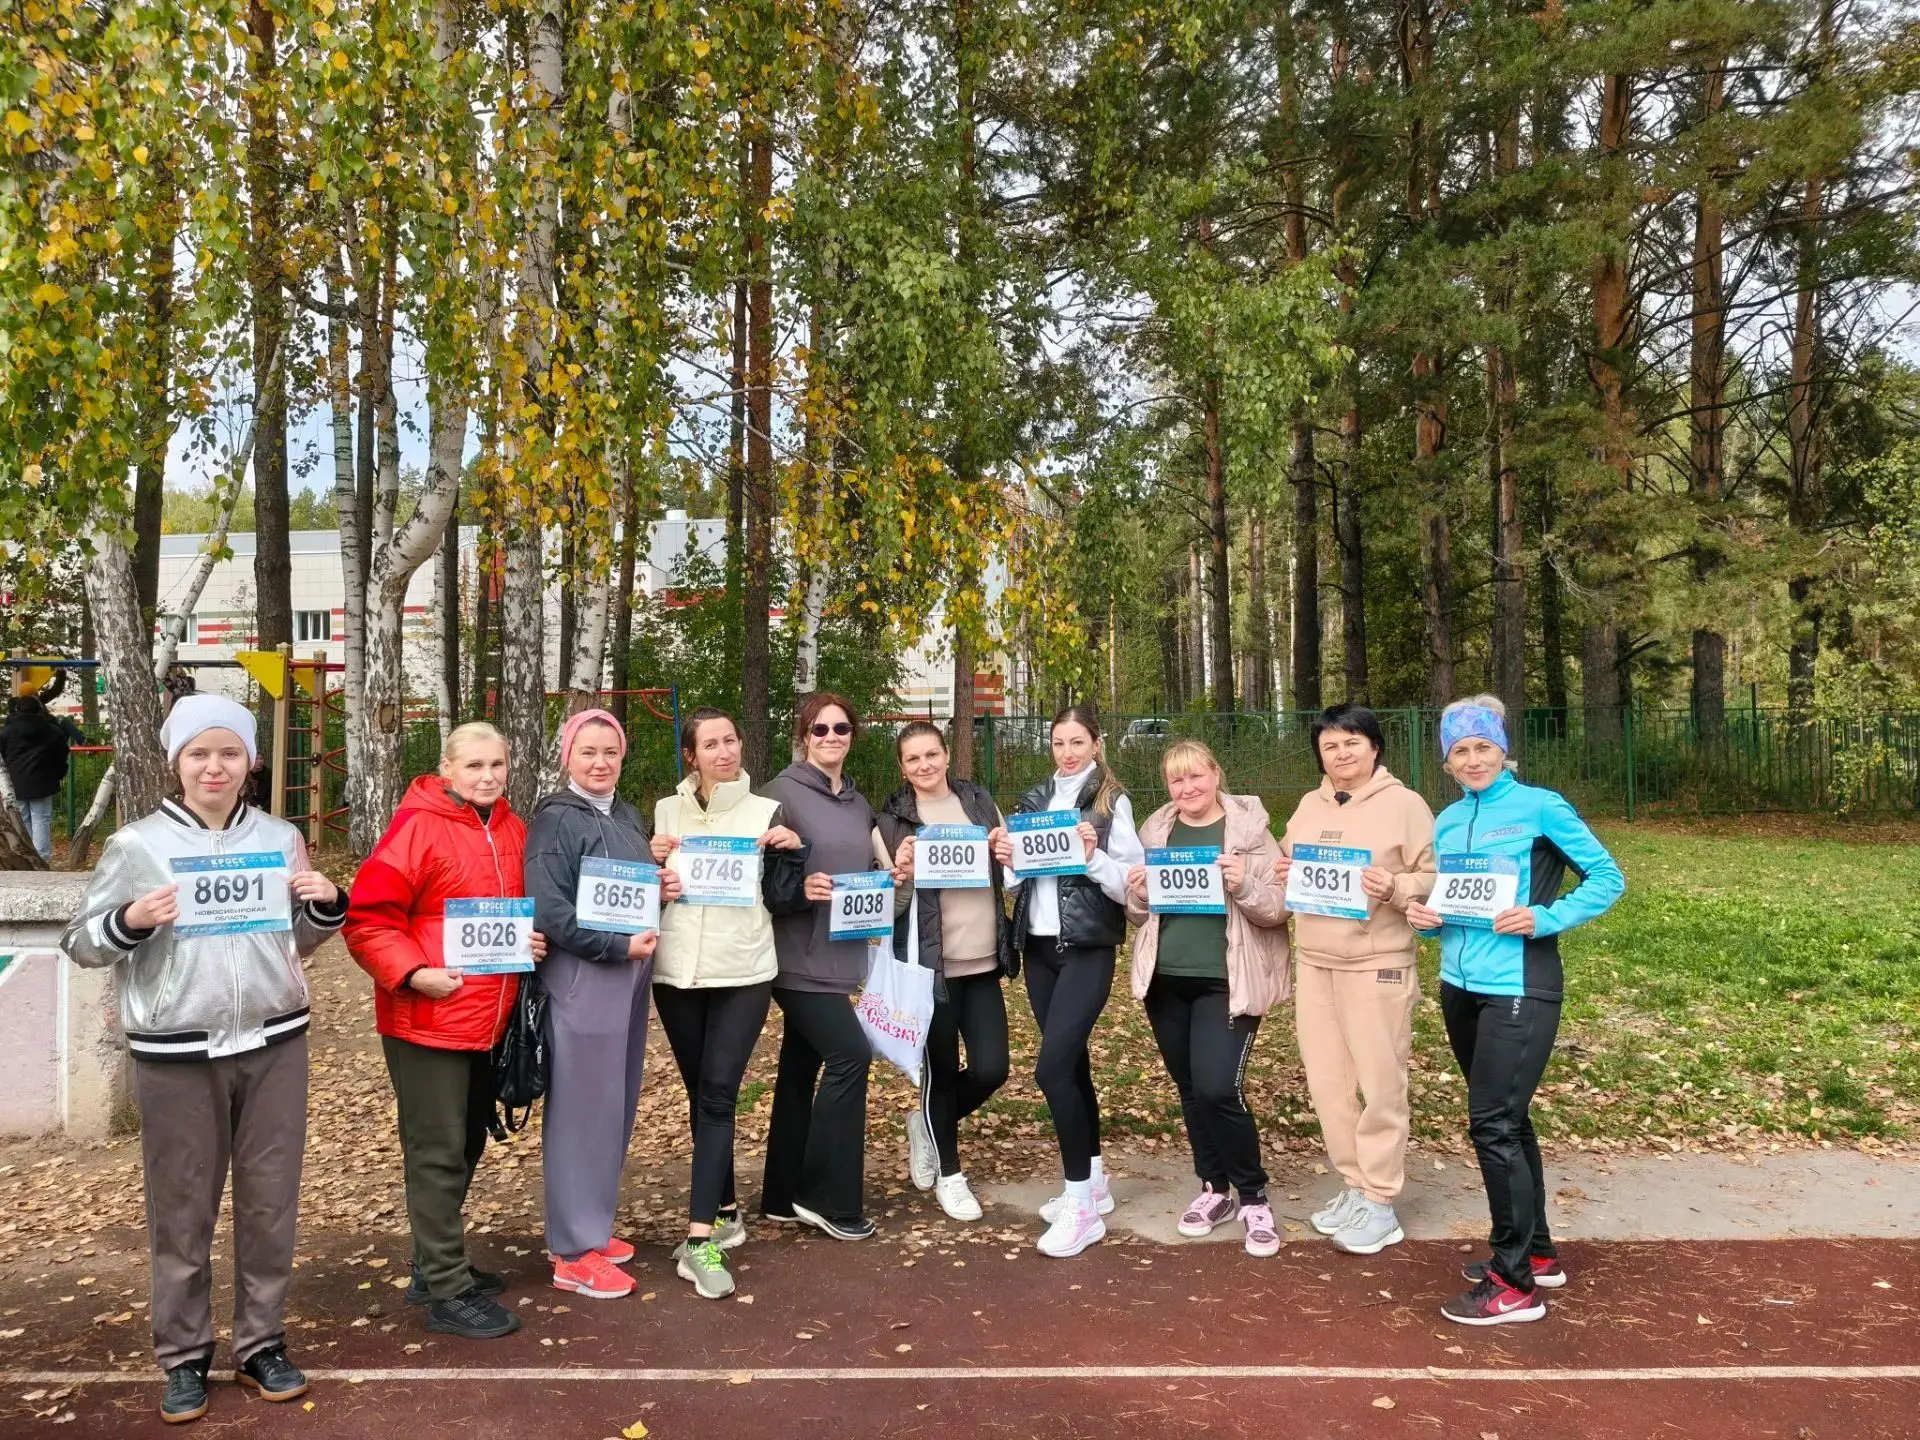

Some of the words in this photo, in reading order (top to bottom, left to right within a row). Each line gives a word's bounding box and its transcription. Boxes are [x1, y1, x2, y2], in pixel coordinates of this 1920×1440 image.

[1031, 815, 1054, 824] КРОСС
[708, 840, 732, 848] КРОСС
[1022, 832, 1070, 856] 8800
[1170, 851, 1194, 859] КРОСС
[1318, 848, 1343, 858] КРОСС
[211, 857, 246, 865] КРОСС
[928, 845, 975, 866] 8860
[1465, 858, 1489, 866] КРОСС
[612, 865, 636, 874] КРОСС
[691, 858, 744, 882] 8746
[1159, 867, 1209, 890] 8098
[1301, 865, 1351, 893] 8631
[194, 873, 264, 904] 8691
[593, 882, 646, 910] 8655
[1445, 878, 1497, 902] 8589
[195, 907, 267, 916] НОВОСИБИРСКАЯ
[479, 901, 504, 910] КРОСС
[843, 892, 884, 916] 8038
[461, 922, 517, 948] 8626
[867, 1007, 921, 1048] Сказку
